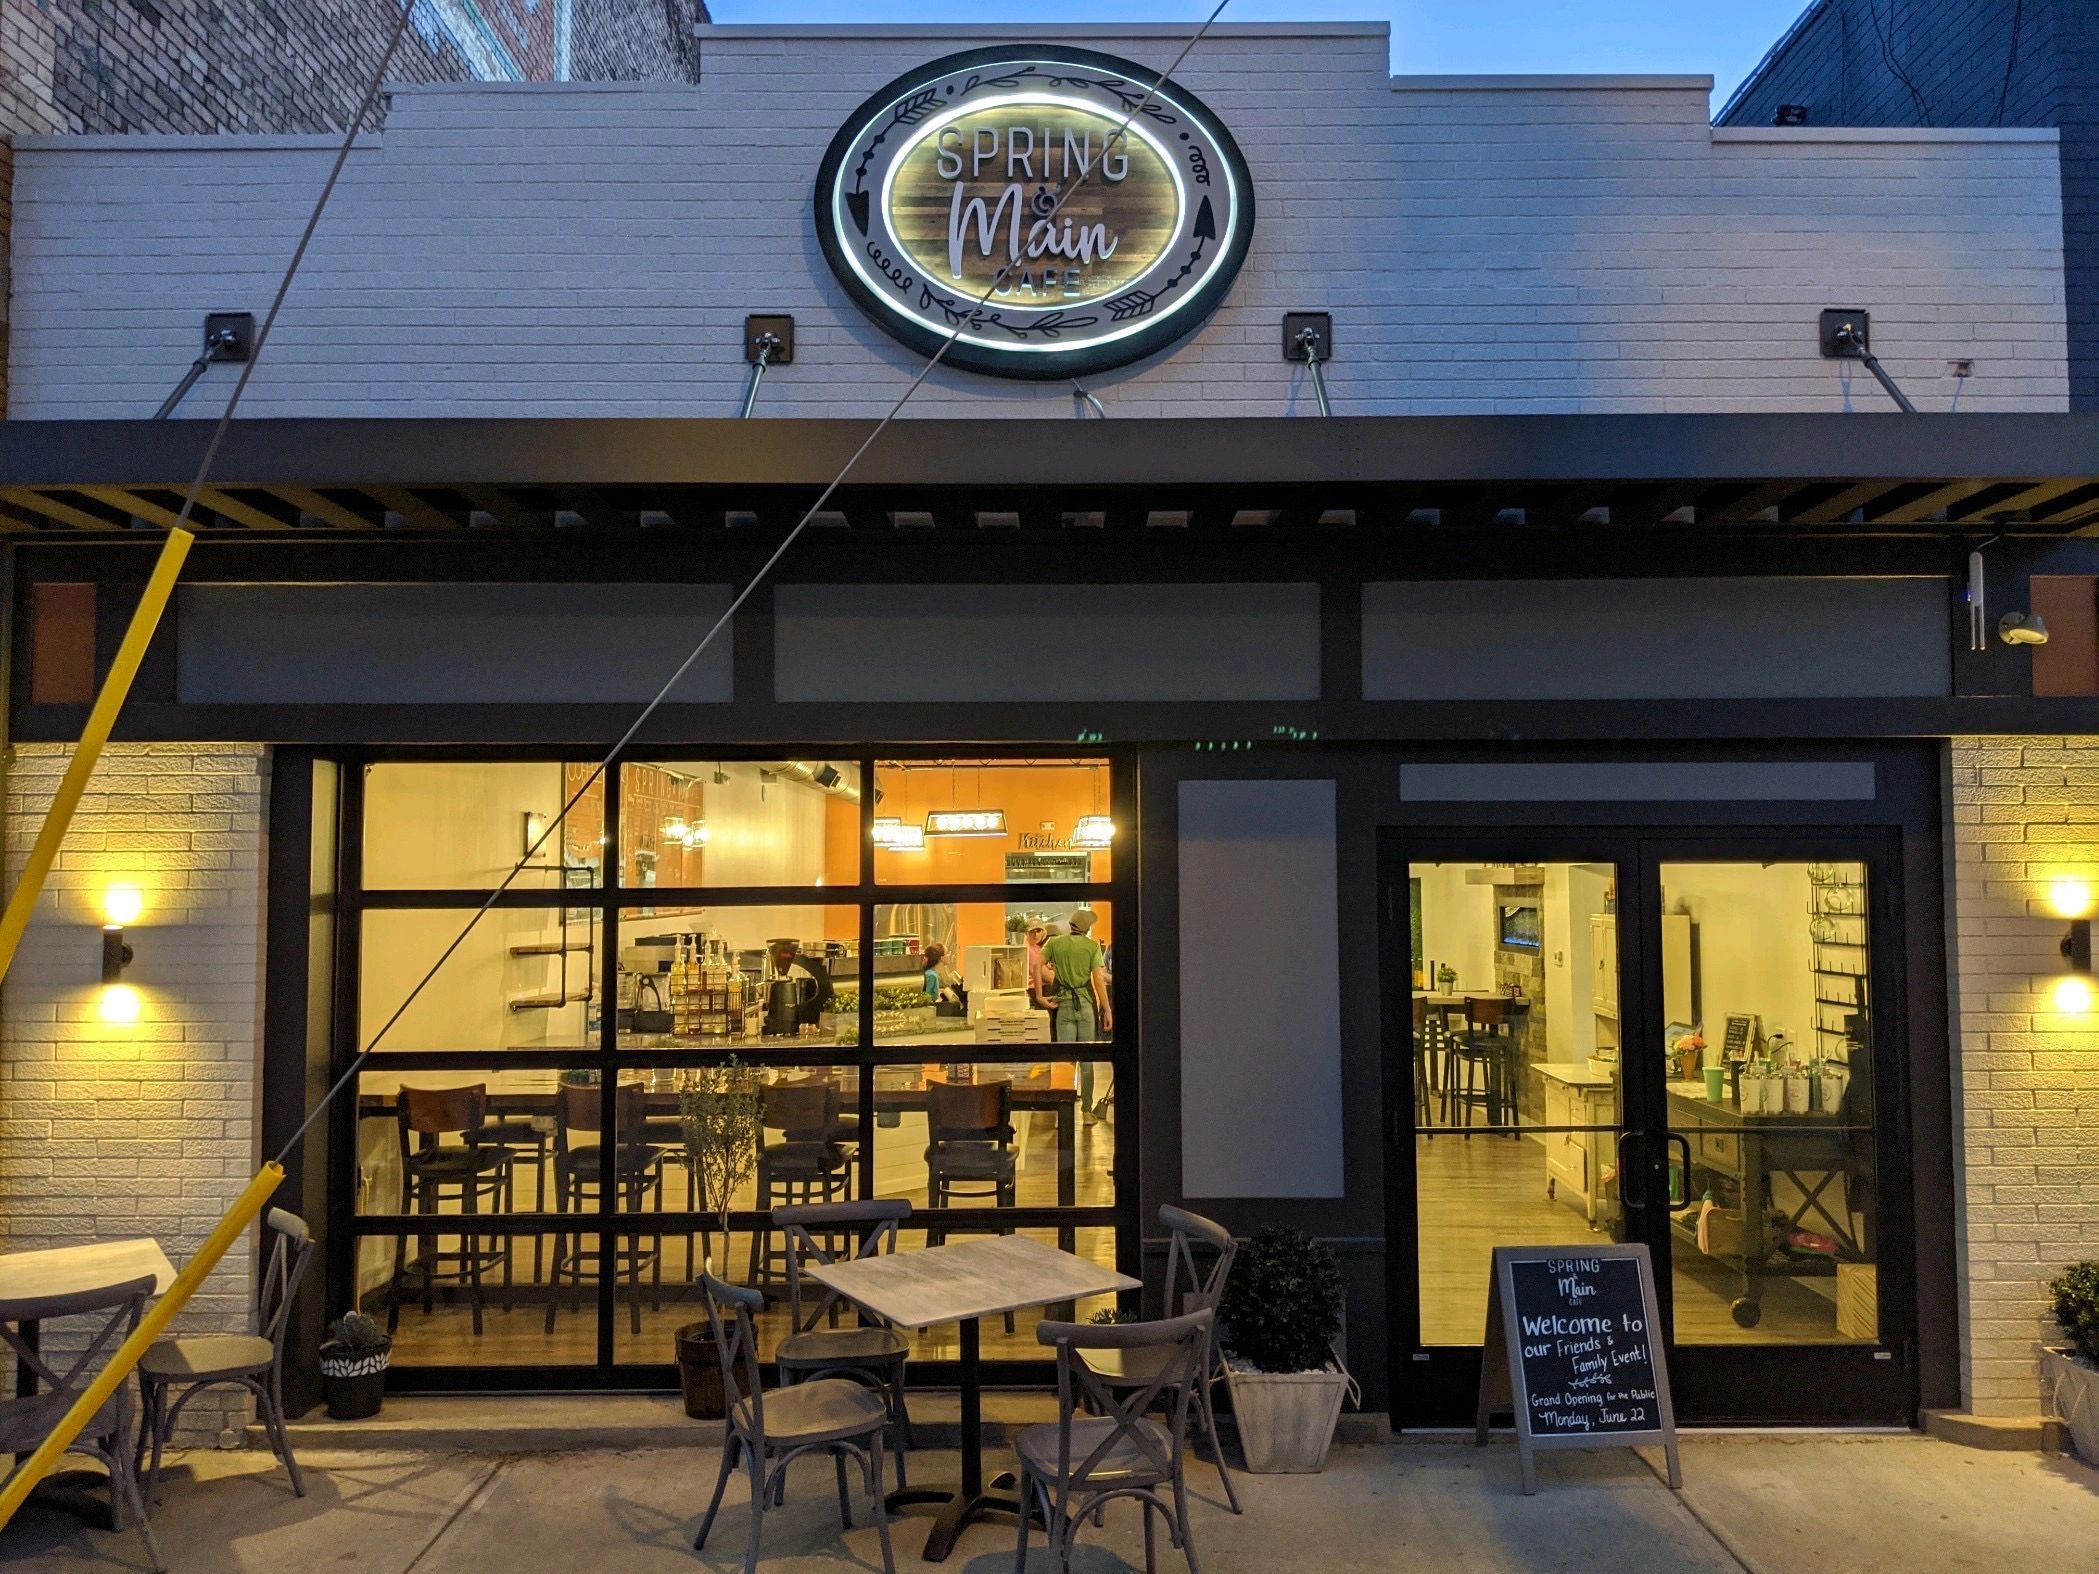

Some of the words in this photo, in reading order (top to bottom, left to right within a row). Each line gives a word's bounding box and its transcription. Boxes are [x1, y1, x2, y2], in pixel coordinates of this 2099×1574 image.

[937, 126, 1129, 182] SPRING
[1031, 185, 1062, 217] &
[948, 181, 1118, 280] Main
[992, 266, 1081, 297] CAFE
[1548, 1259, 1600, 1273] SPRING
[1558, 1277, 1597, 1298] Main
[1522, 1315, 1613, 1337] Welcome
[1622, 1313, 1643, 1332] to
[1524, 1343, 1552, 1358] our
[1556, 1336, 1602, 1357] Friends
[1607, 1335, 1614, 1346] &
[1571, 1354, 1608, 1375] Family
[1611, 1344, 1648, 1367] Event!
[1531, 1393, 1562, 1407] Grand
[1564, 1392, 1603, 1408] Opening
[1630, 1389, 1656, 1400] Public
[1538, 1411, 1595, 1431] Monday,
[1599, 1408, 1628, 1424] June
[1629, 1407, 1646, 1421] 22
